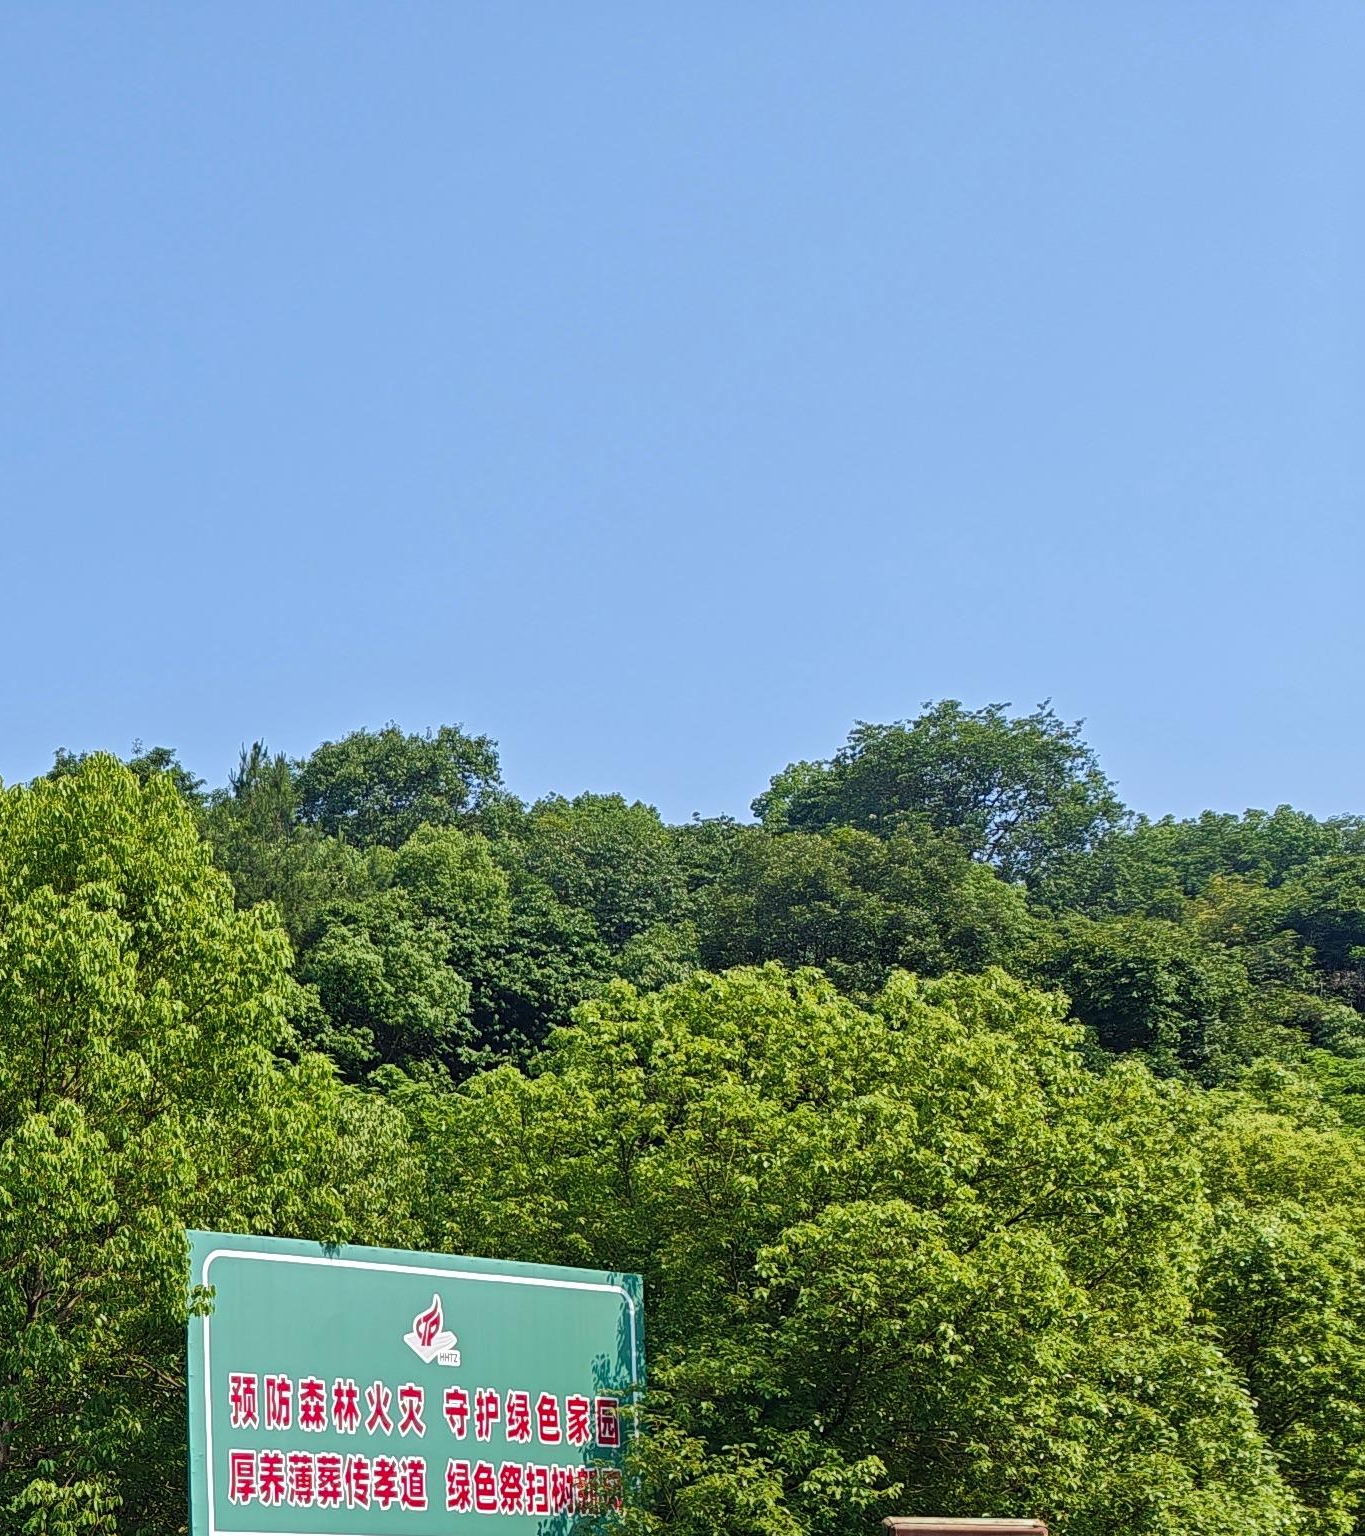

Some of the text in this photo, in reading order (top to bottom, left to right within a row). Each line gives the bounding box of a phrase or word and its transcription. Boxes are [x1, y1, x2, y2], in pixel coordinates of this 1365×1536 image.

[230, 1374, 620, 1447] 预防森林火灾 守护绿色家园
[230, 1450, 427, 1510] 厚养薄葬传孝道
